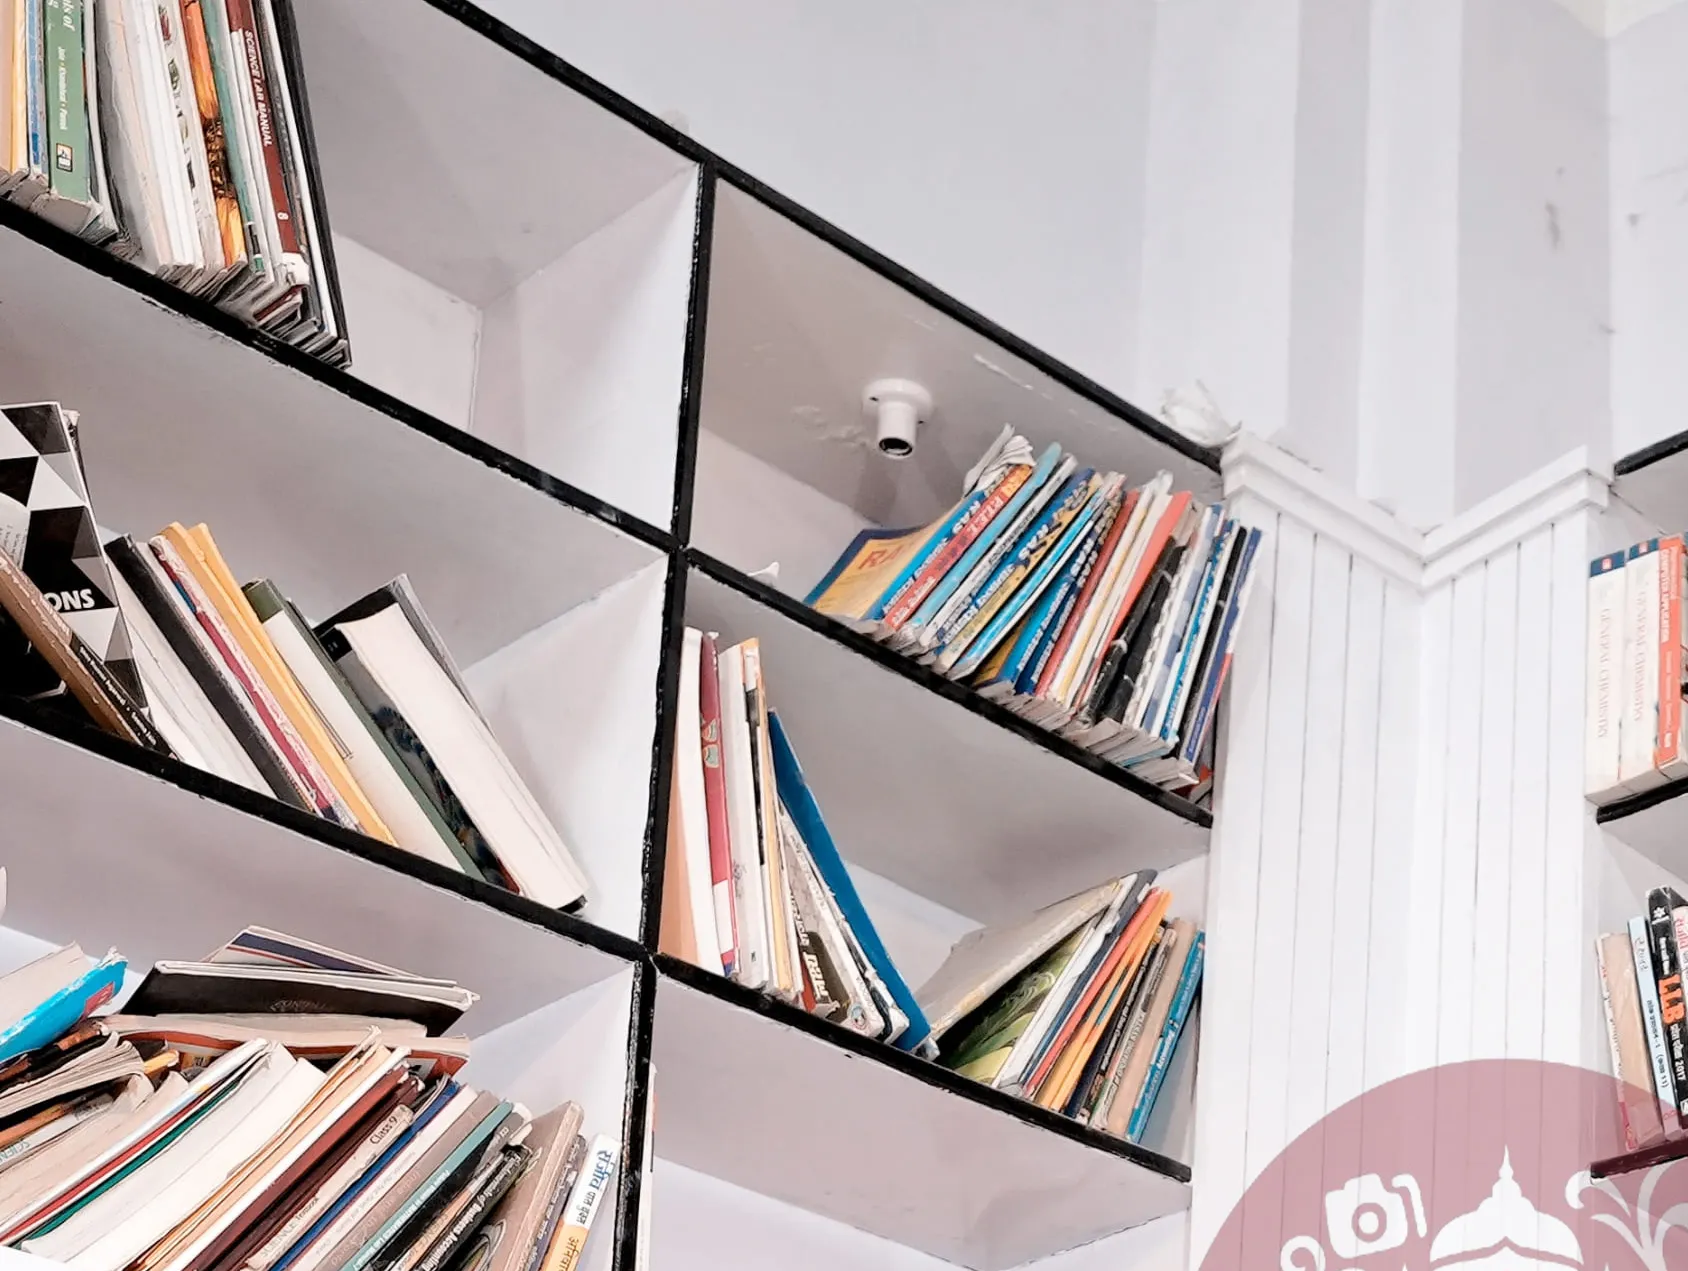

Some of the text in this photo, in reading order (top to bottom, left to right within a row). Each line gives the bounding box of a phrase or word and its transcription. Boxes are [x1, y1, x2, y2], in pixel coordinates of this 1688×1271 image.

[242, 30, 260, 77] SCIENCE
[255, 102, 273, 147] MANUAL
[277, 210, 288, 220] 8
[1596, 609, 1612, 736] GENERAL CHEMISTRY
[1630, 592, 1648, 721] GENERAL CHEMISTRY
[1657, 974, 1686, 1023] LLB
[1674, 1061, 1685, 1080] 2017
[368, 1115, 398, 1145] Class 9
[481, 1153, 521, 1200] Fundamentals
[585, 1148, 614, 1190] संजीव
[452, 1203, 482, 1236] Business
[474, 1195, 488, 1208] of
